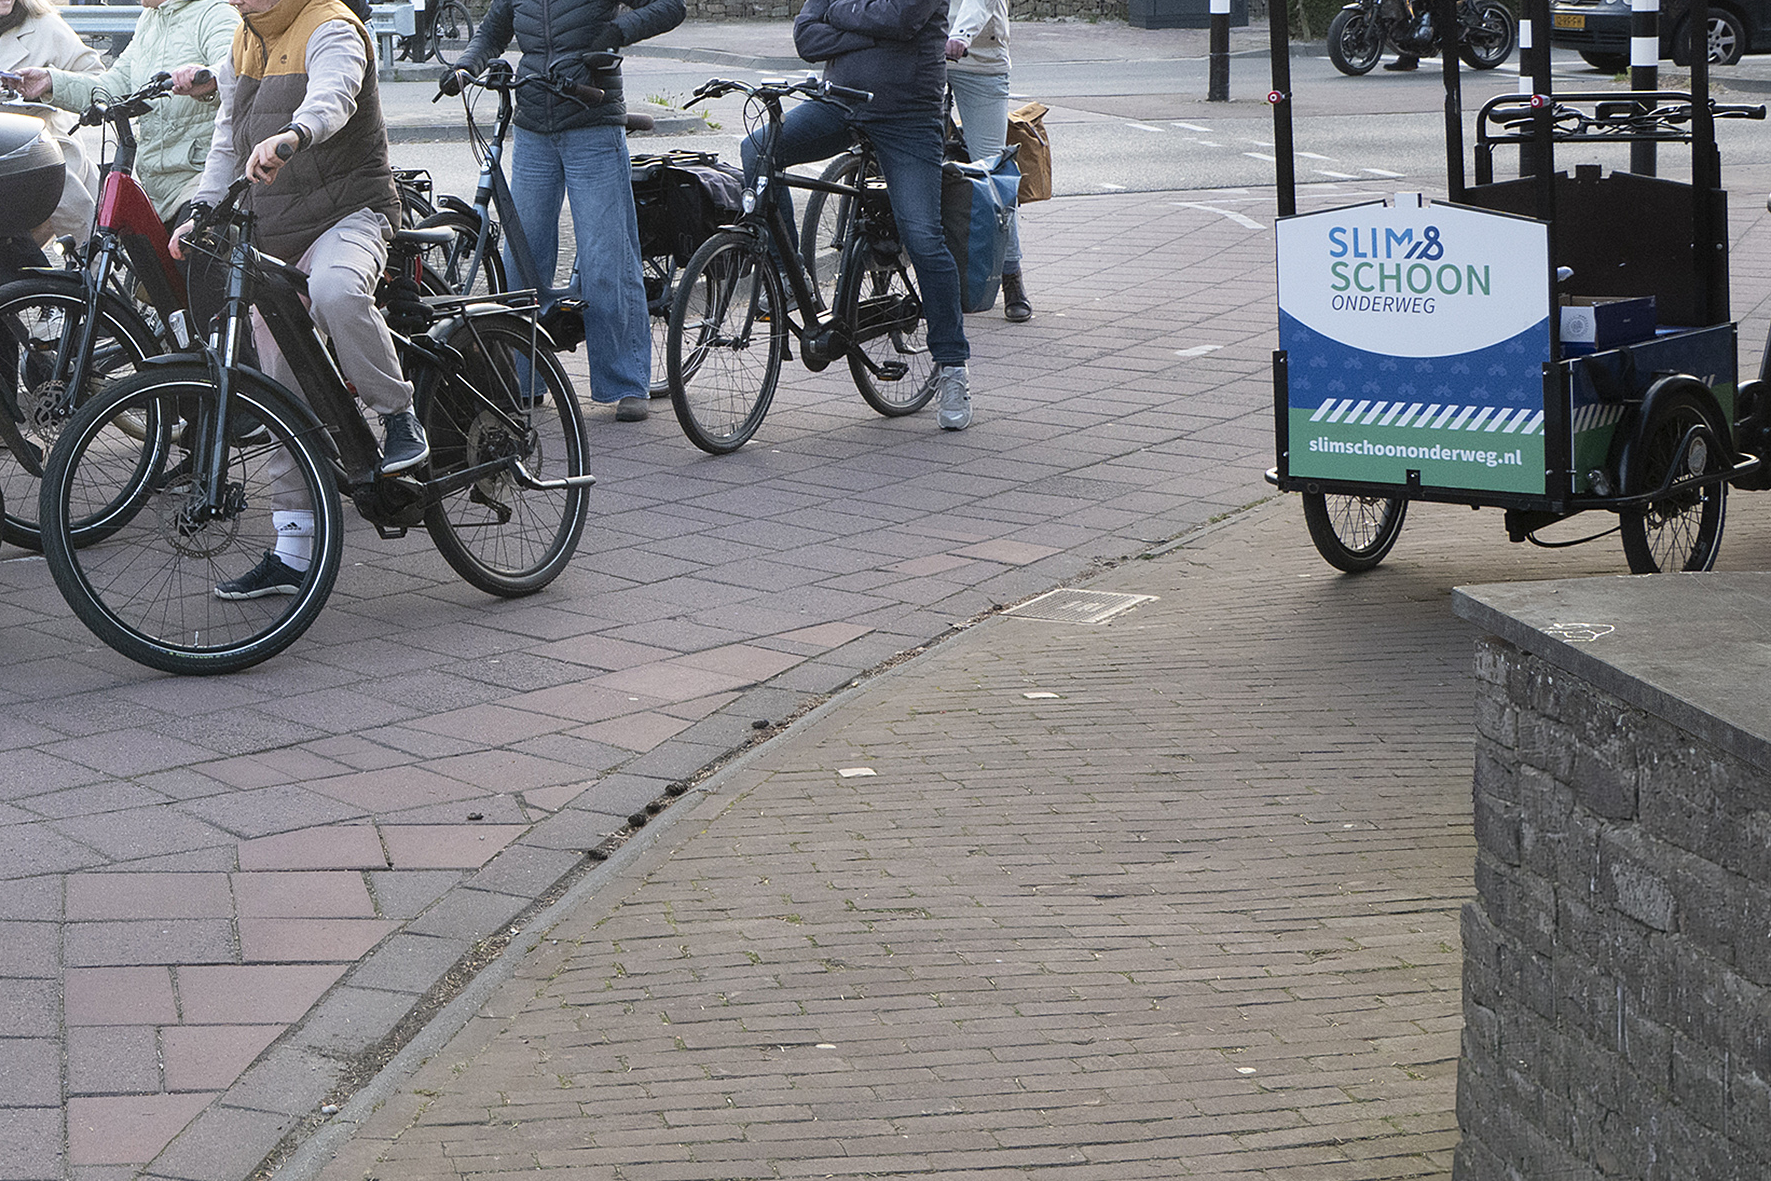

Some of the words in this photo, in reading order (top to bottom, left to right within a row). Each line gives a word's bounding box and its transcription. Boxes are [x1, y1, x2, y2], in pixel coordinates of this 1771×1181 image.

[1328, 226, 1414, 259] SLIM
[1330, 261, 1491, 296] SCHOON
[1331, 294, 1436, 315] ONDERWEG
[1308, 436, 1523, 467] slimschoononderweg.nl
